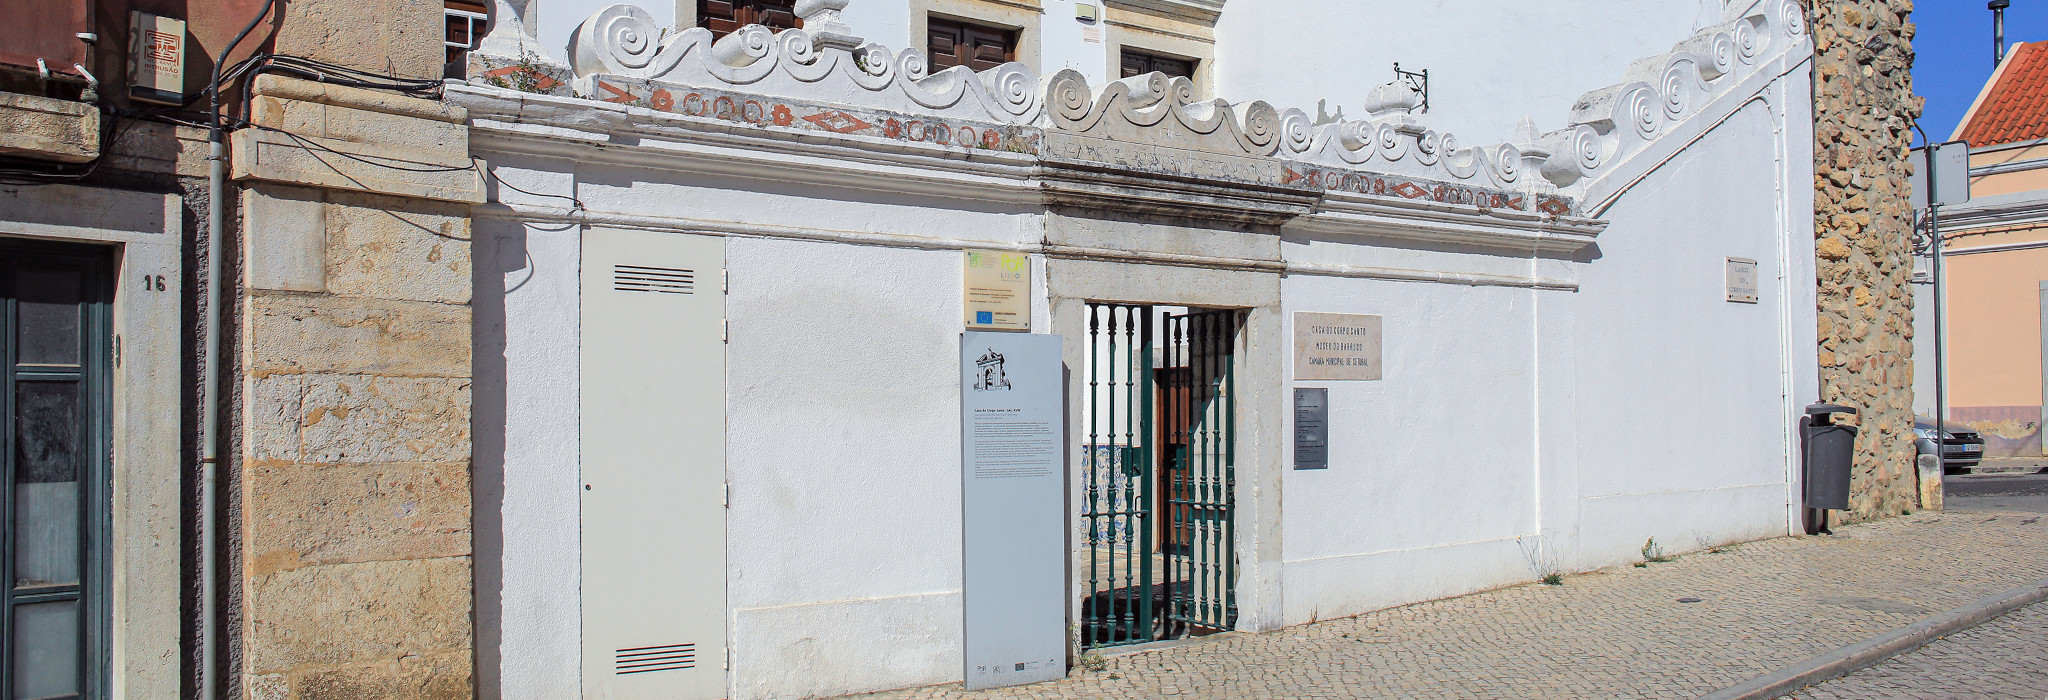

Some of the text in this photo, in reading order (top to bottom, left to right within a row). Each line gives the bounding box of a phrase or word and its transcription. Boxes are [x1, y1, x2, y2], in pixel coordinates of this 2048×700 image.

[144, 63, 179, 74] INTRUSÃO
[1001, 254, 1024, 271] POR
[144, 274, 166, 291] 16
[1312, 325, 1366, 336] CASA DO CORPO SANTO
[1316, 341, 1363, 351] MUSEU DO BARROCO
[1325, 357, 1344, 367] MUNICIPAL
[1346, 357, 1351, 366] DE
